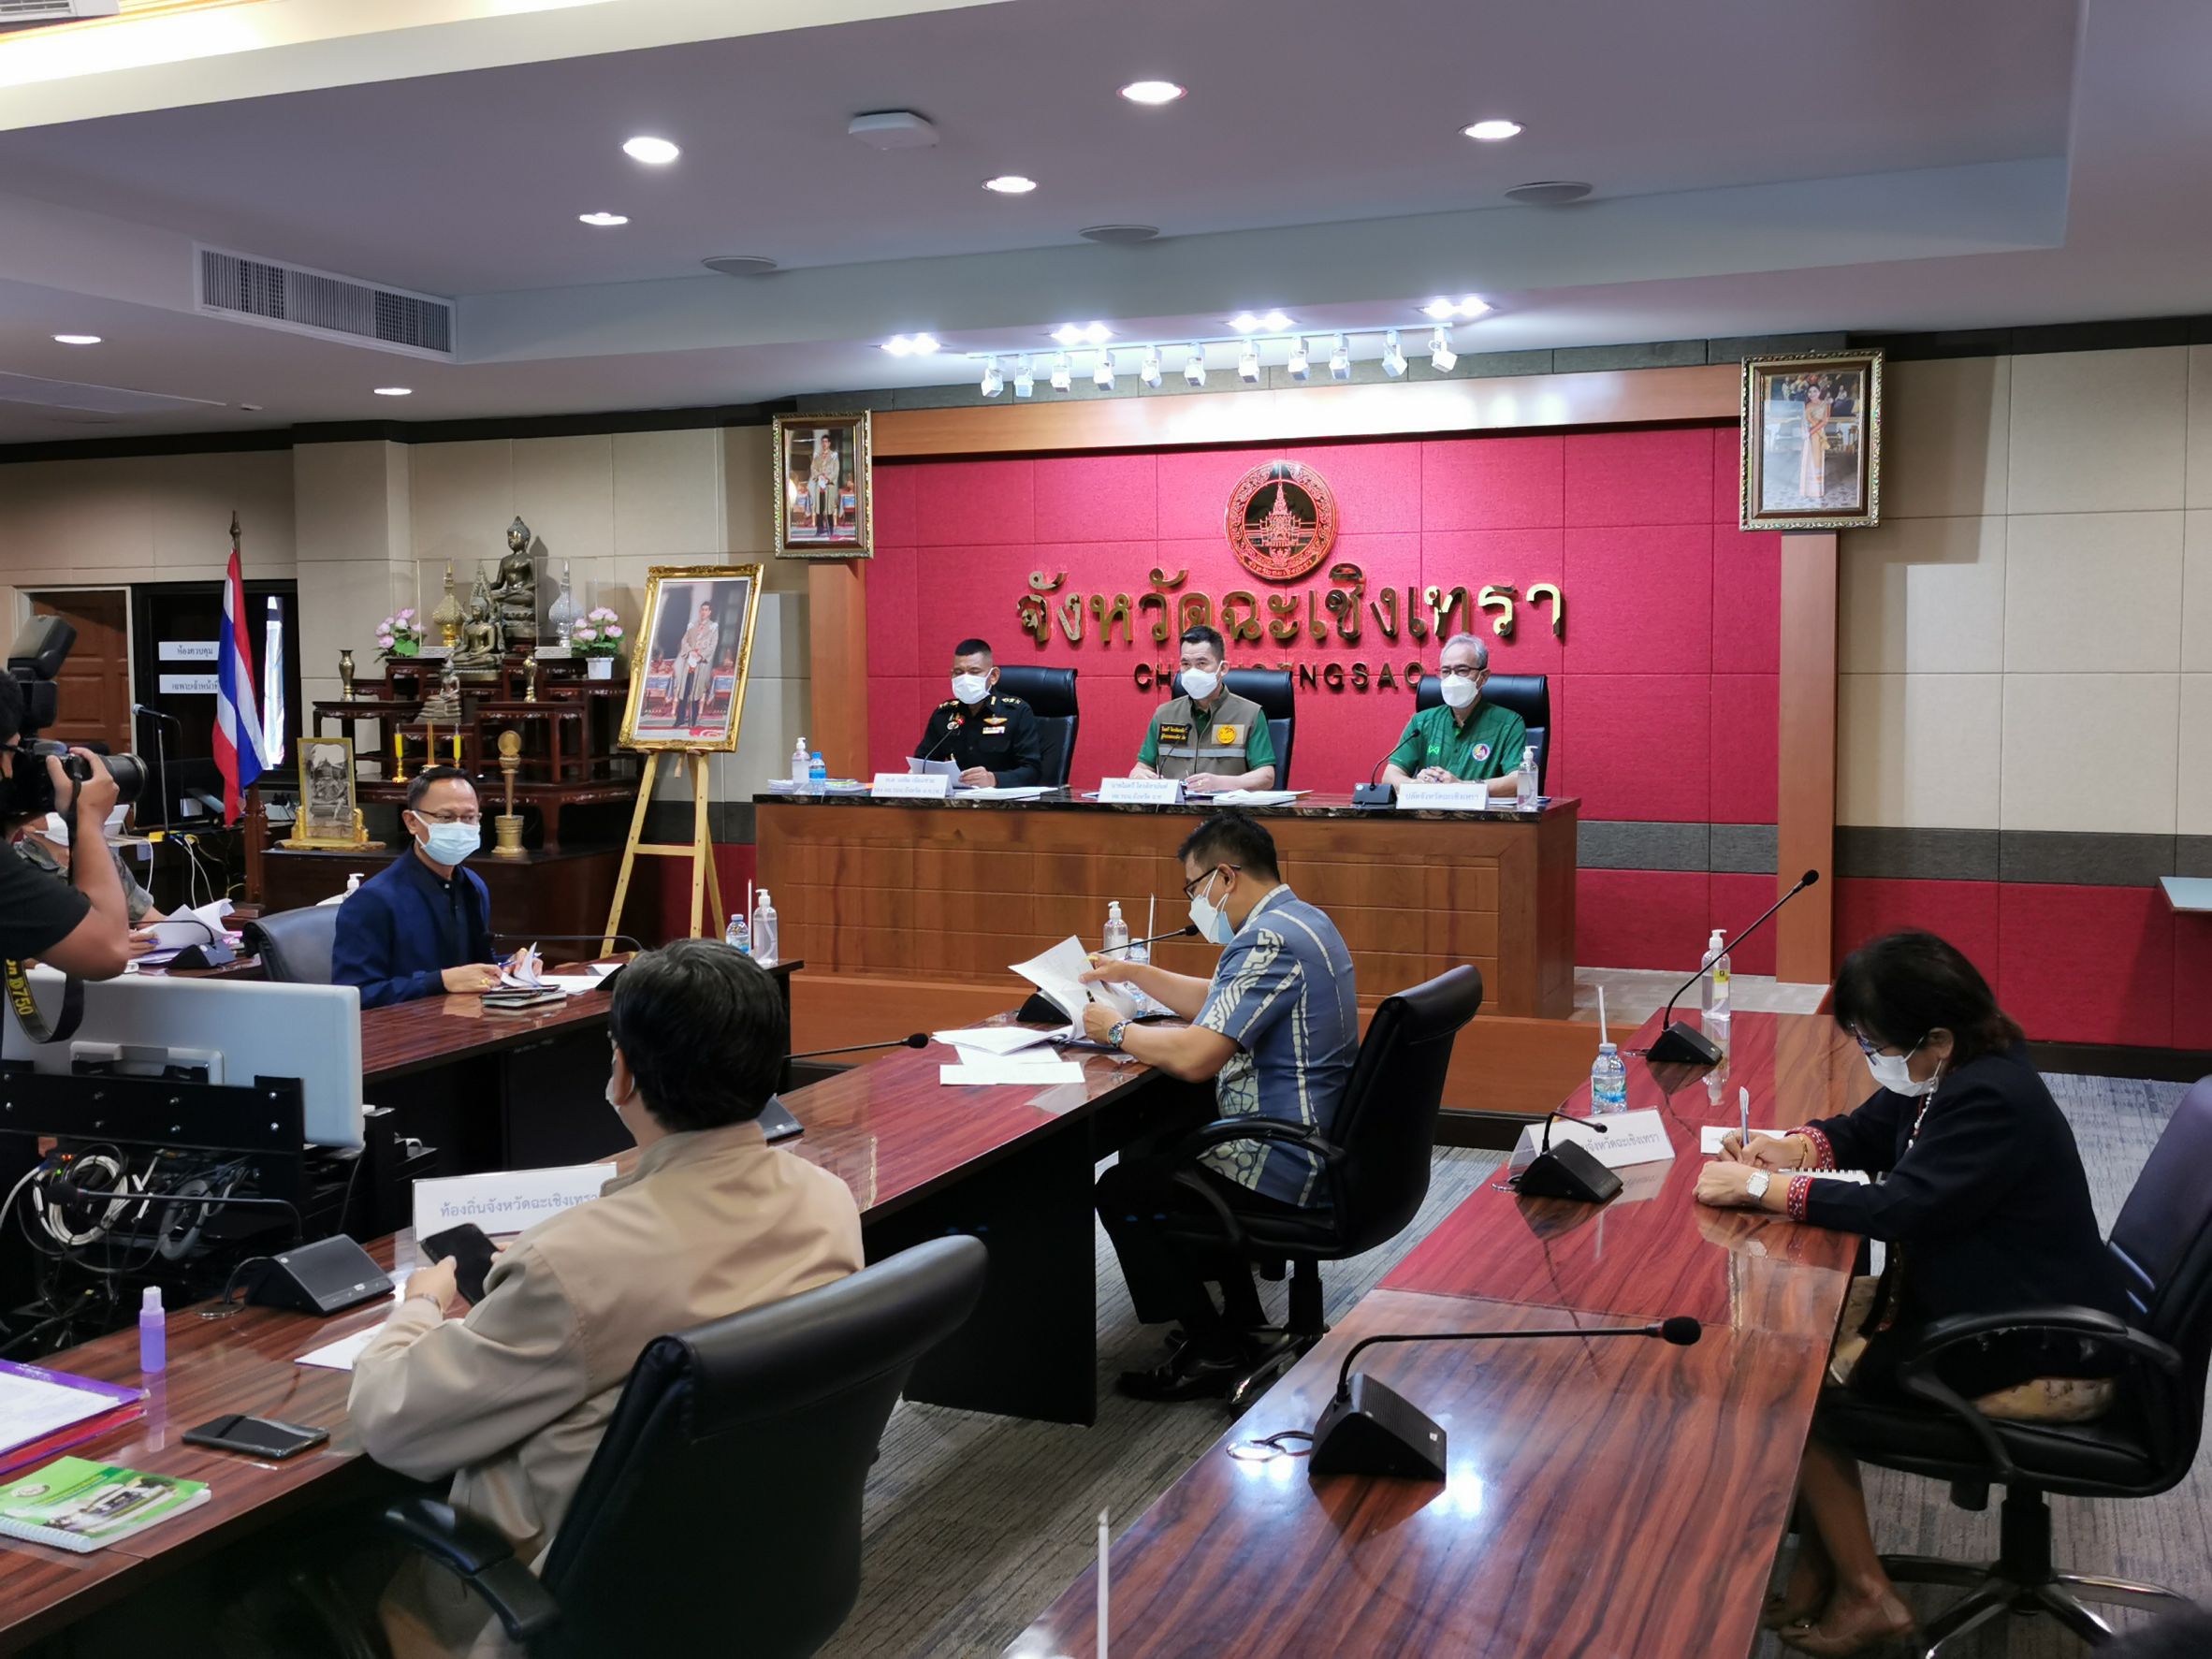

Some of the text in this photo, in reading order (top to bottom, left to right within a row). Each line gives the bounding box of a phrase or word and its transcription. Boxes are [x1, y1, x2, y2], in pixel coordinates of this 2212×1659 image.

[1017, 561, 1563, 643] จังหวัดฉะเชิงเทรา
[177, 645, 213, 657] ห้องควบคุม
[1134, 662, 1426, 691] CHNGSAO
[8, 977, 34, 1015] D750
